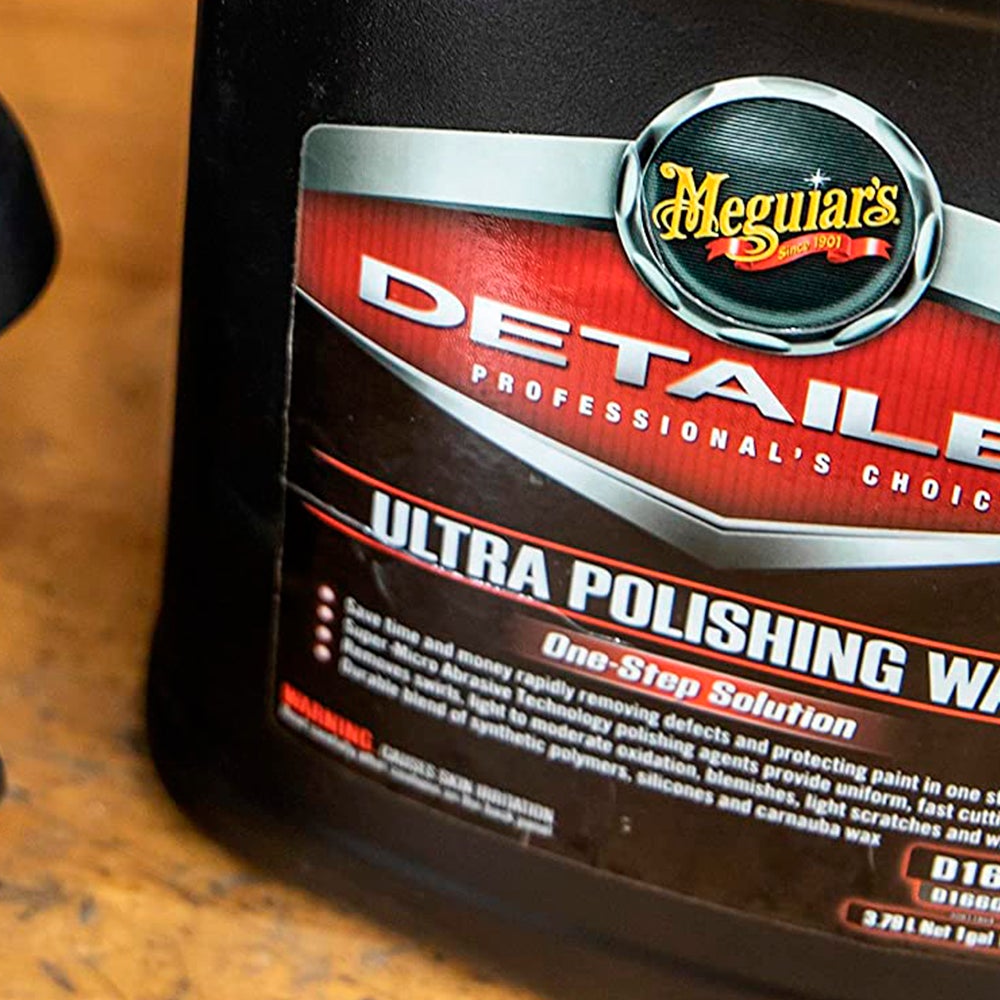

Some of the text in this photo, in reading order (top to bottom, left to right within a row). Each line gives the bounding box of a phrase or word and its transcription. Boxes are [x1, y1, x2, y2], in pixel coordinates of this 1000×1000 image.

[652, 162, 900, 261] Meguiar's
[778, 236, 842, 260] Since 1901
[471, 364, 991, 512] PROFESSIONAL'S CHOIC
[370, 489, 551, 601] ULTRA
[567, 559, 906, 696] POLISHING
[280, 680, 374, 753] WARNING
[438, 767, 474, 795] SKIN
[338, 656, 882, 848] Durable blend of synthetic polymers, silicones and carnauba wax
[340, 636, 411, 683] Removes
[467, 691, 507, 720] light
[508, 706, 528, 727] to
[529, 716, 613, 754] moderate
[615, 742, 701, 781] oxidation,
[704, 765, 801, 808] blemishes,
[804, 792, 847, 819] light
[850, 805, 942, 839] scratches
[945, 826, 982, 846] and
[343, 596, 382, 628] Save
[383, 616, 421, 644] time
[422, 635, 455, 659] and
[456, 648, 513, 681] money
[514, 669, 575, 702] rapidly
[577, 688, 661, 728] removing
[663, 713, 731, 744] defects
[734, 734, 769, 755] and
[771, 744, 868, 783] protecting
[871, 768, 920, 793] paint
[922, 775, 942, 796] in
[945, 783, 981, 802] one
[440, 661, 513, 699] Abrasive
[515, 687, 613, 734] Technology
[614, 720, 695, 760] polishing
[699, 748, 760, 774] agents
[762, 762, 832, 793] provide
[835, 779, 913, 813] uniform,
[917, 797, 955, 820] fast
[541, 631, 858, 740] One-Step Solution
